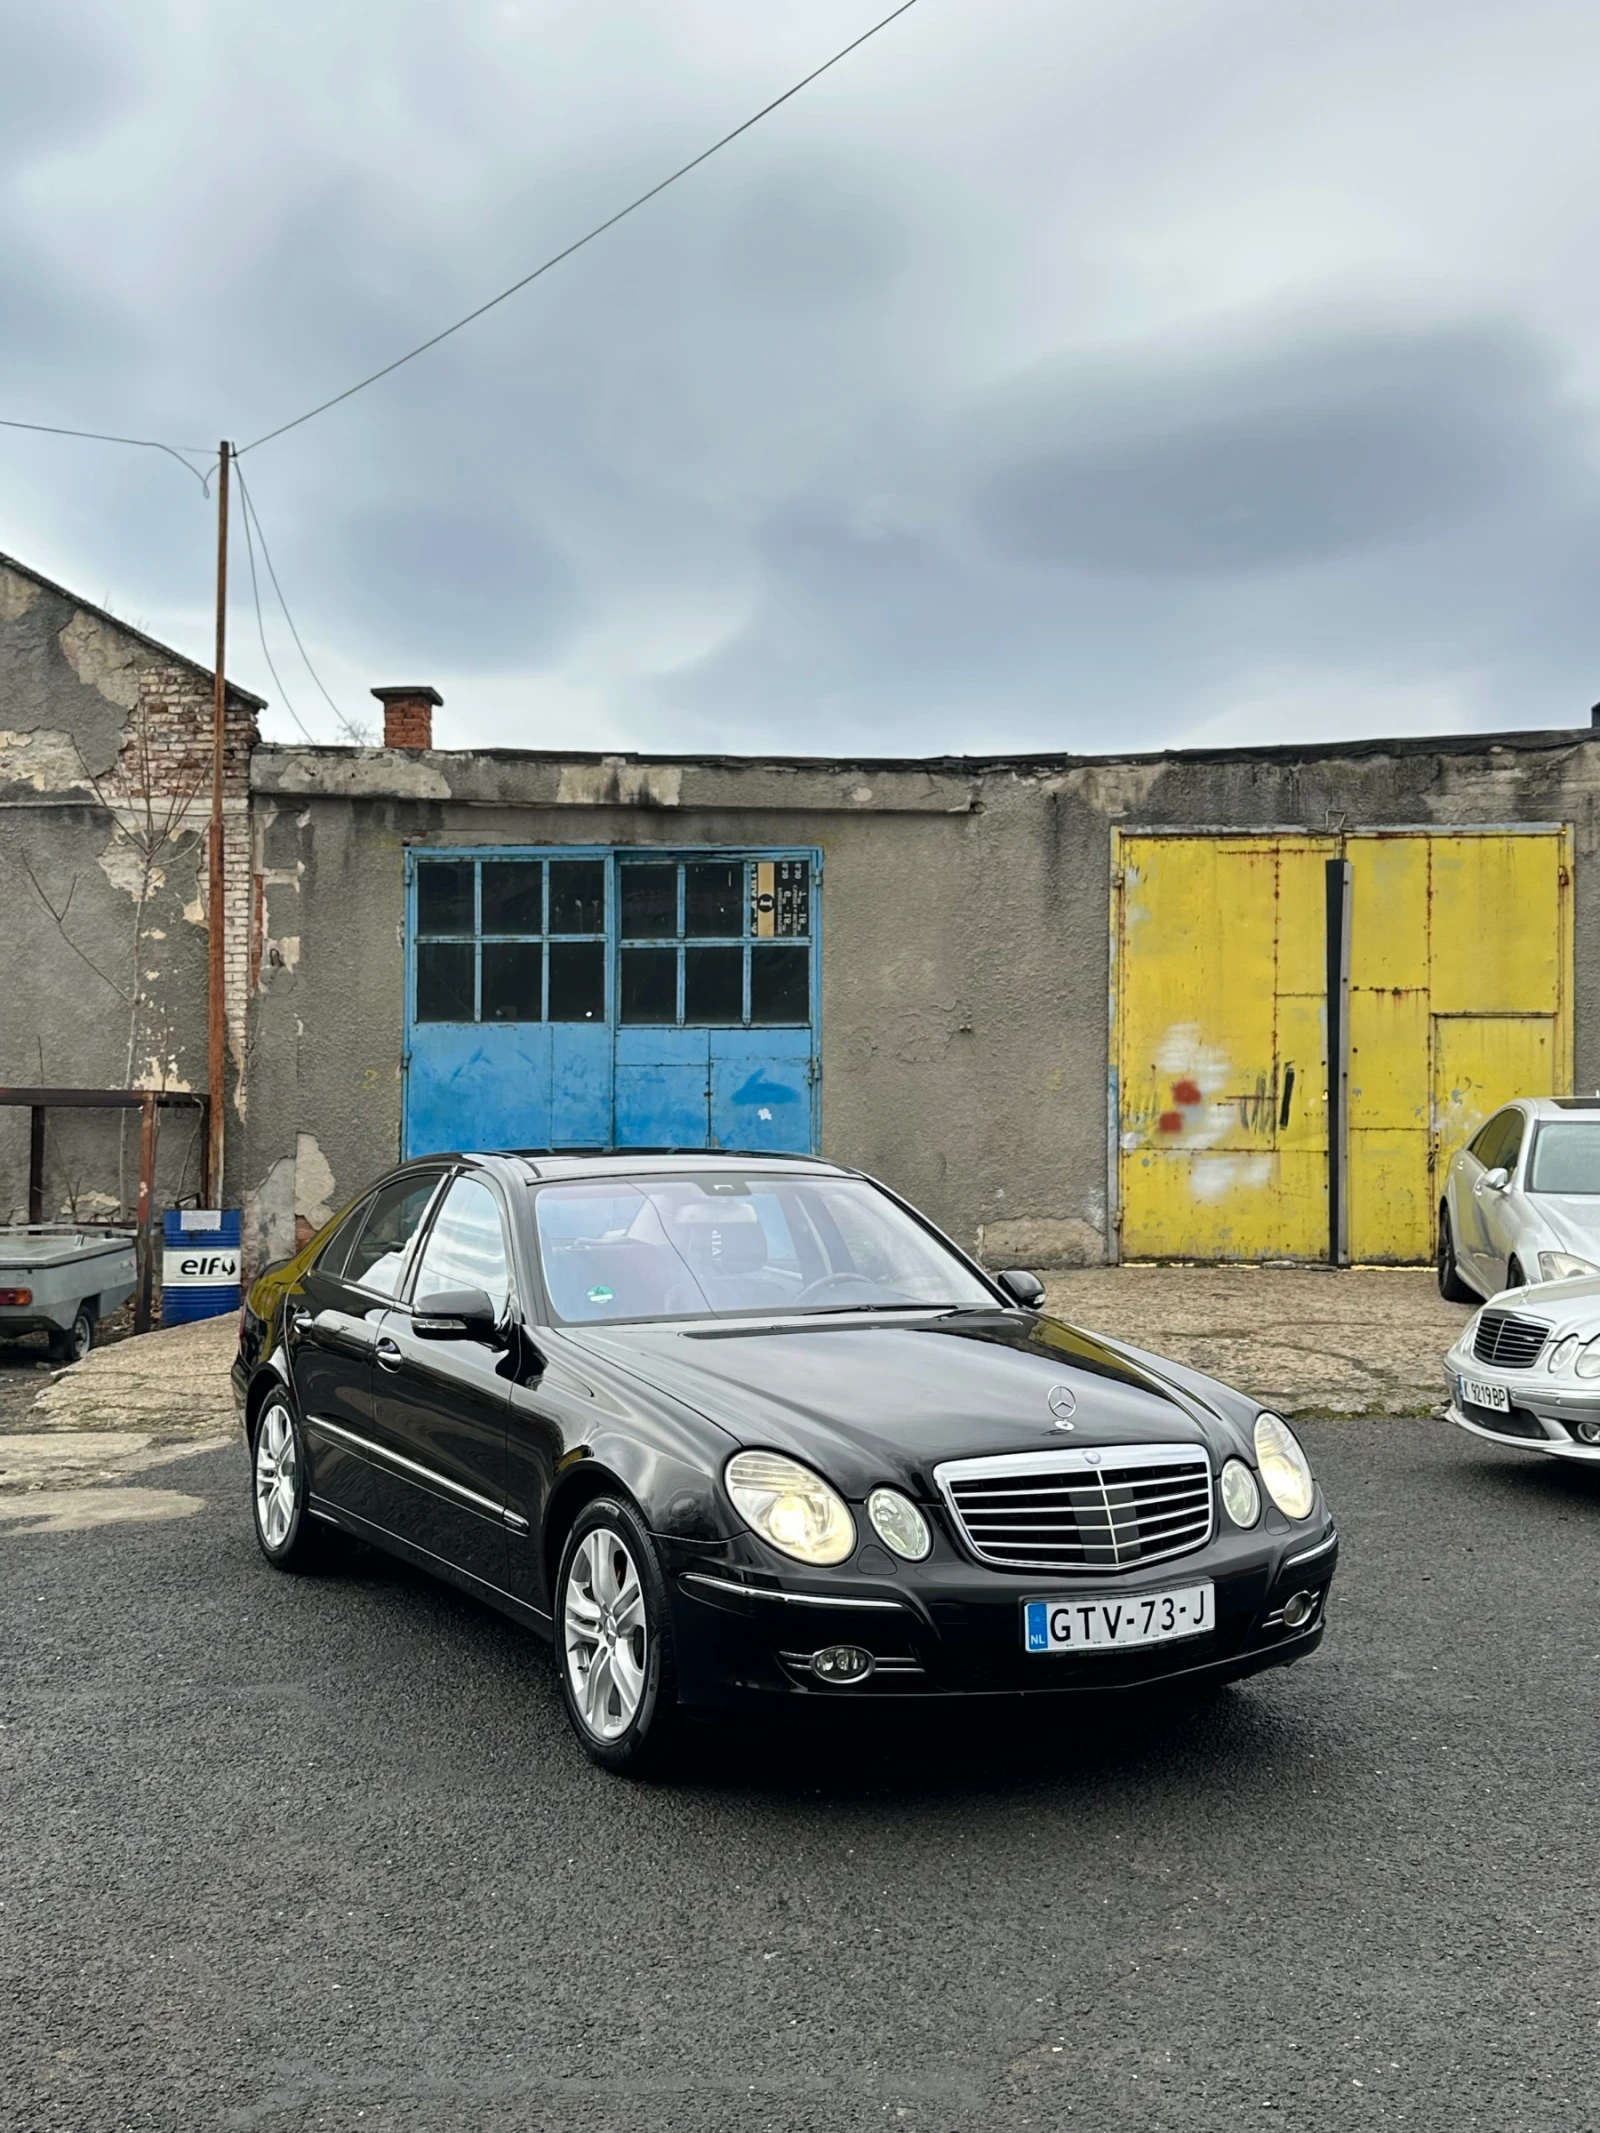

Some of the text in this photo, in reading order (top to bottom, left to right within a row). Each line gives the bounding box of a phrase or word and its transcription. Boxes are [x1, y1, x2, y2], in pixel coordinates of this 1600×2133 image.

[181, 1257, 221, 1275] elf
[1050, 1591, 1204, 1642] GTV-73-J
[1031, 1635, 1045, 1644] NL
